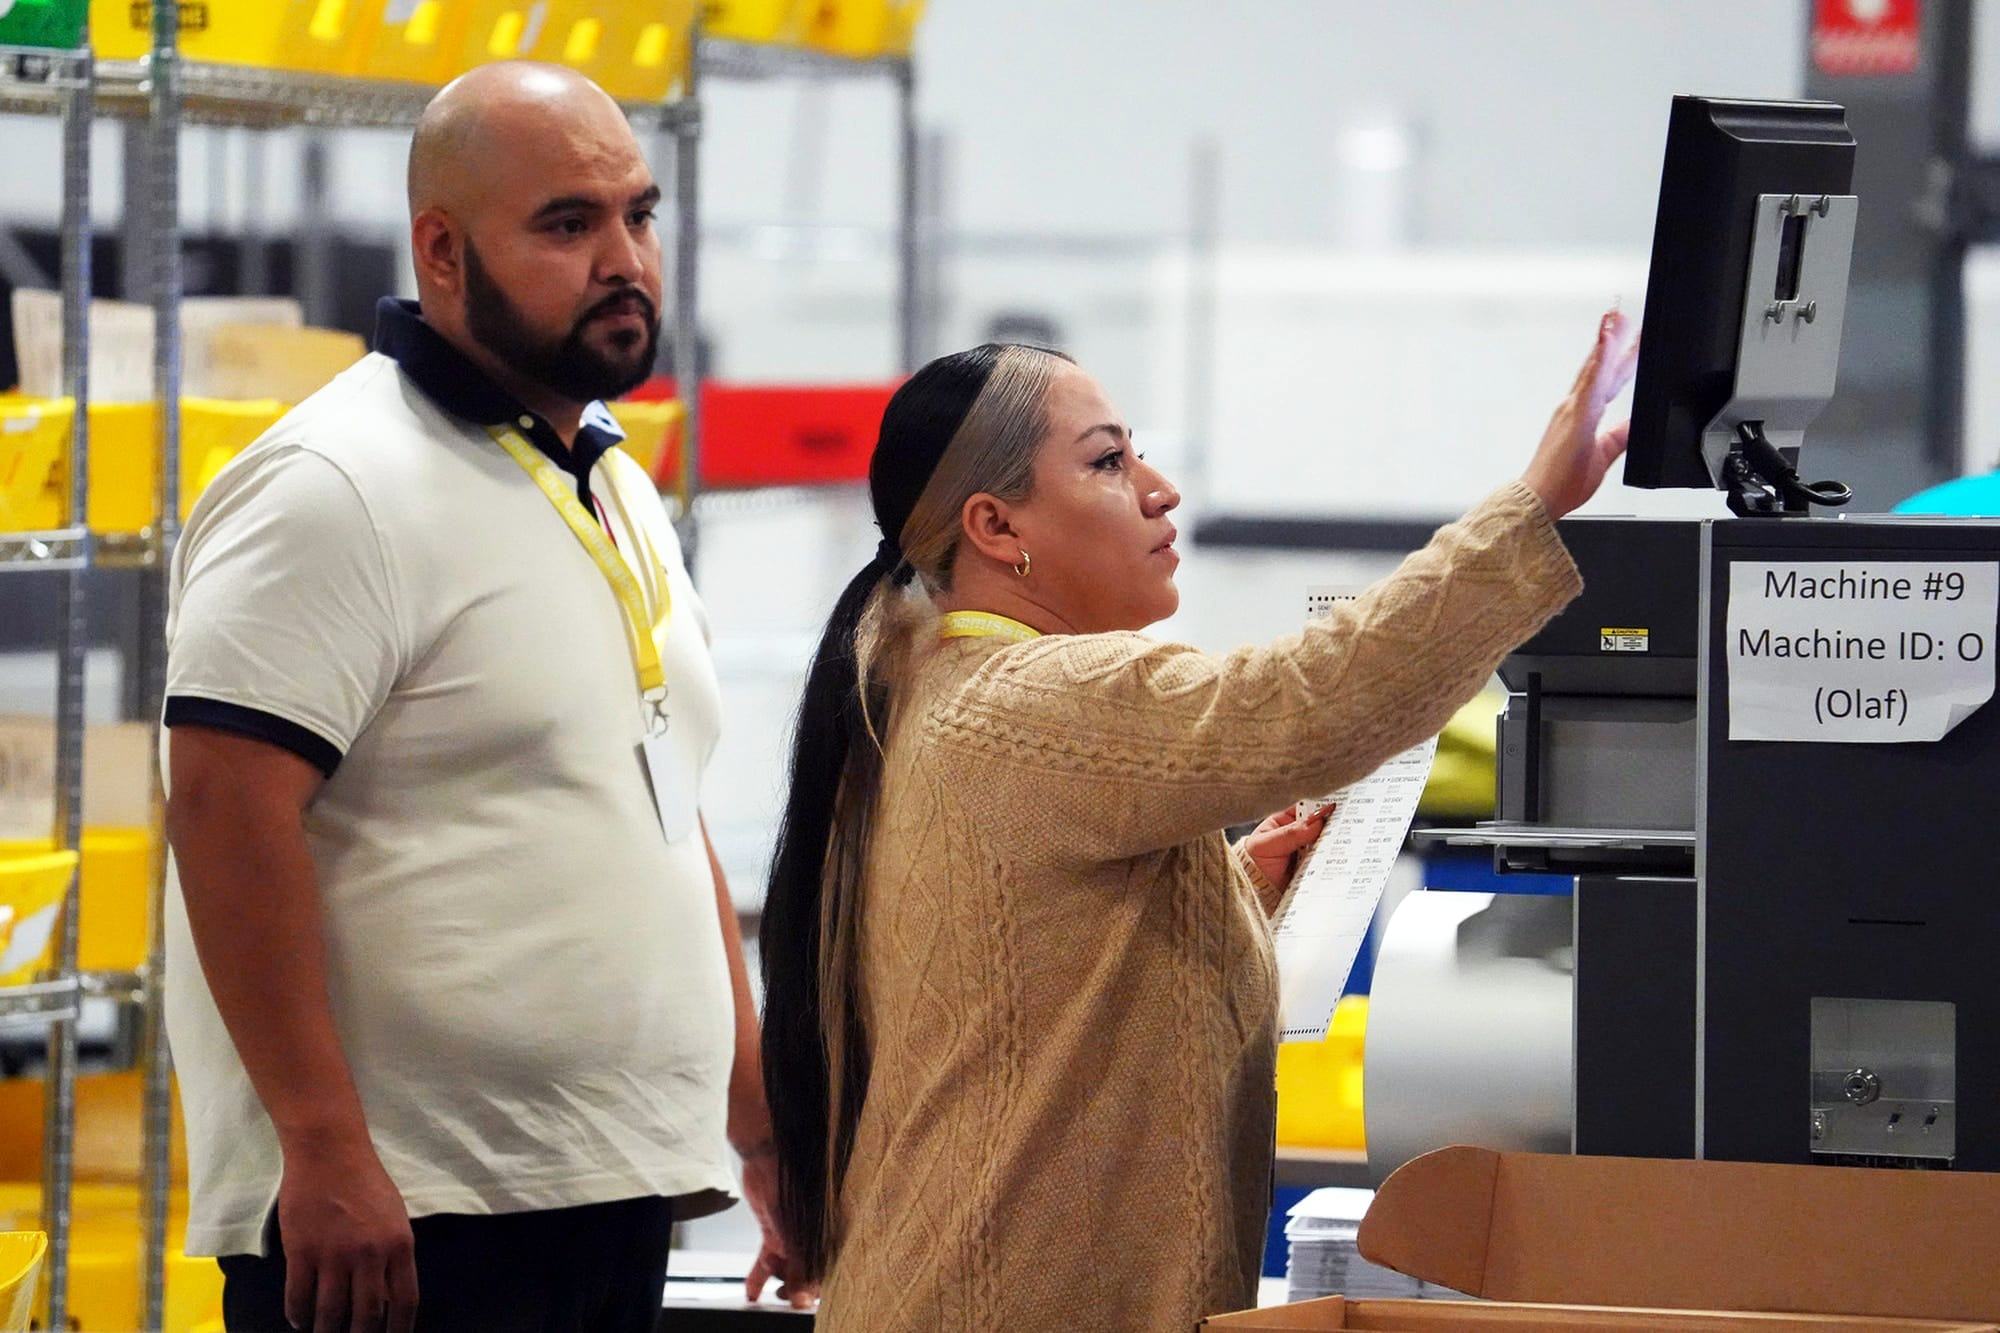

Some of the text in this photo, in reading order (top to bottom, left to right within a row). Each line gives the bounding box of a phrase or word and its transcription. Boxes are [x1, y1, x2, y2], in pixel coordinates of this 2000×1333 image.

[1764, 569, 1965, 601] Machine #9
[1739, 628, 1984, 662] Machine ID: O
[1814, 687, 1908, 727] (Olaf)
